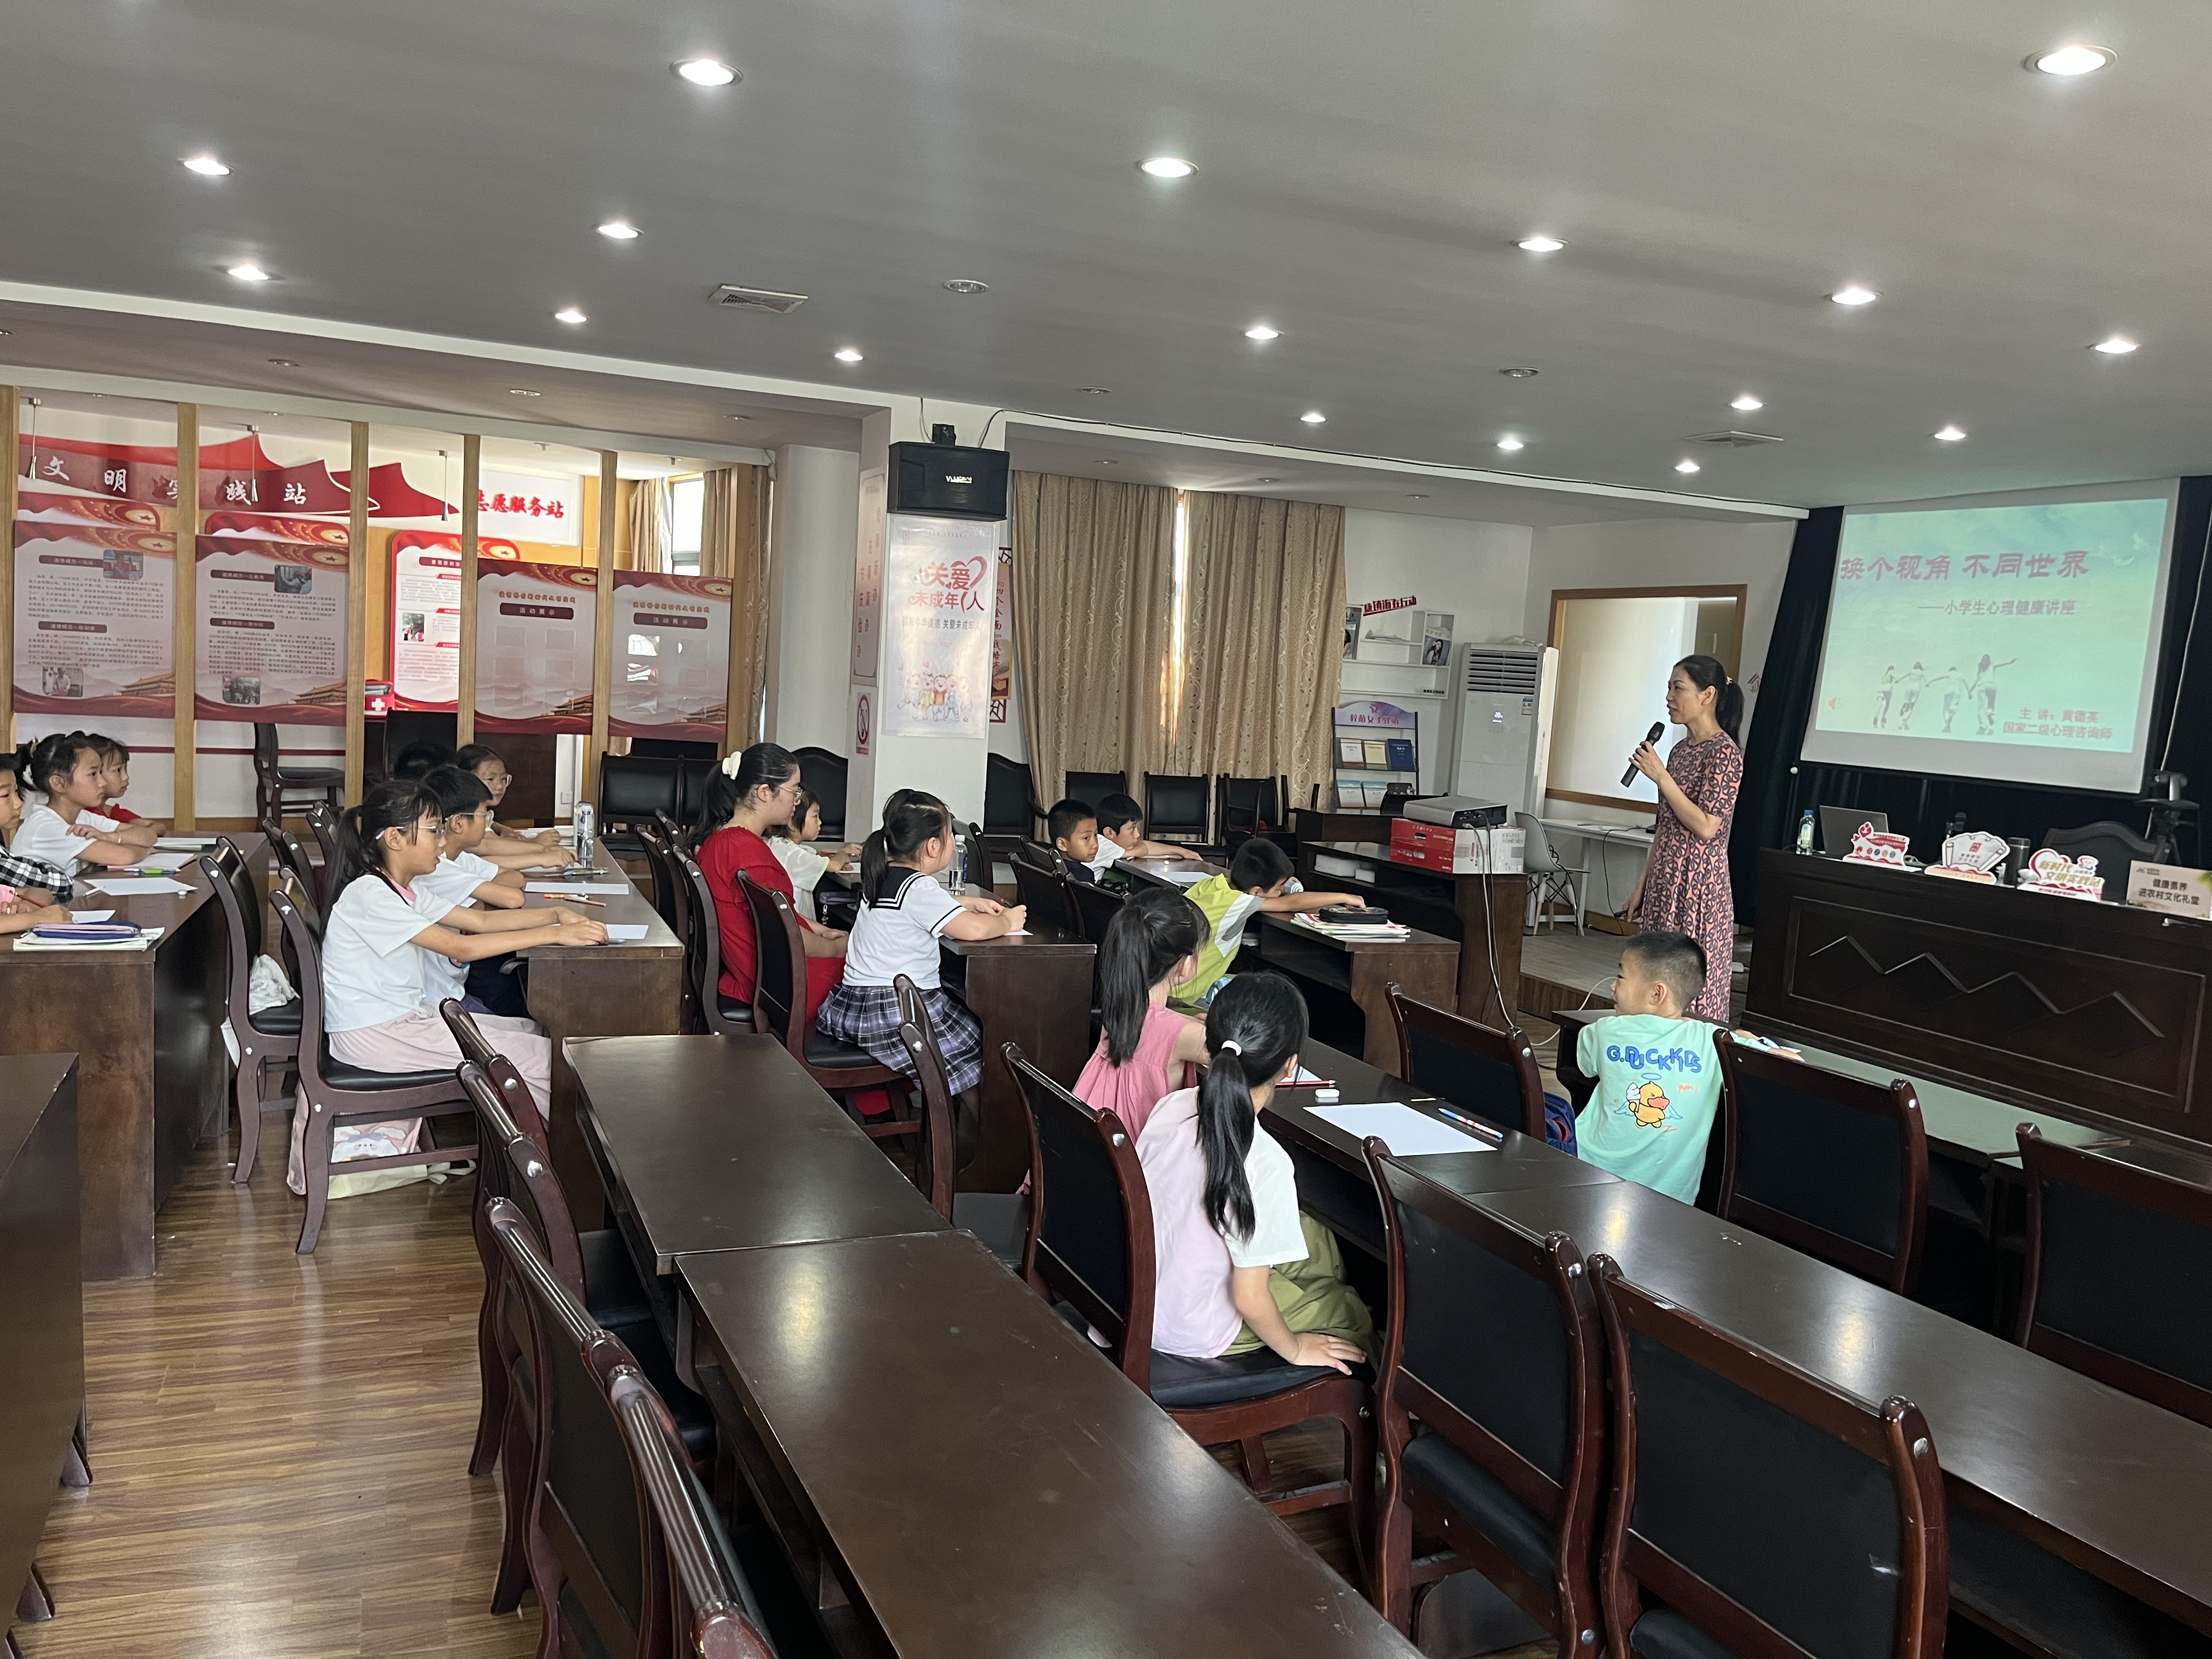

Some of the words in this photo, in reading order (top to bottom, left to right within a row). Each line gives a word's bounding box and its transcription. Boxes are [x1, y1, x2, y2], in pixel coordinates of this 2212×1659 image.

[1840, 554, 1951, 580] 换个视角
[1962, 550, 2089, 579] 不同世界
[921, 558, 974, 591] 关爱
[909, 590, 985, 613] 未成年人
[520, 607, 555, 616] 活动展示
[653, 617, 689, 625] 活动展示
[943, 619, 981, 631] 关爱未成年人
[2003, 721, 2113, 739] 国家二级心理咨询师
[2039, 860, 2074, 873] 新时代
[2044, 871, 2102, 887] 文明实践站
[2138, 888, 2199, 905] 进农村文化礼堂
